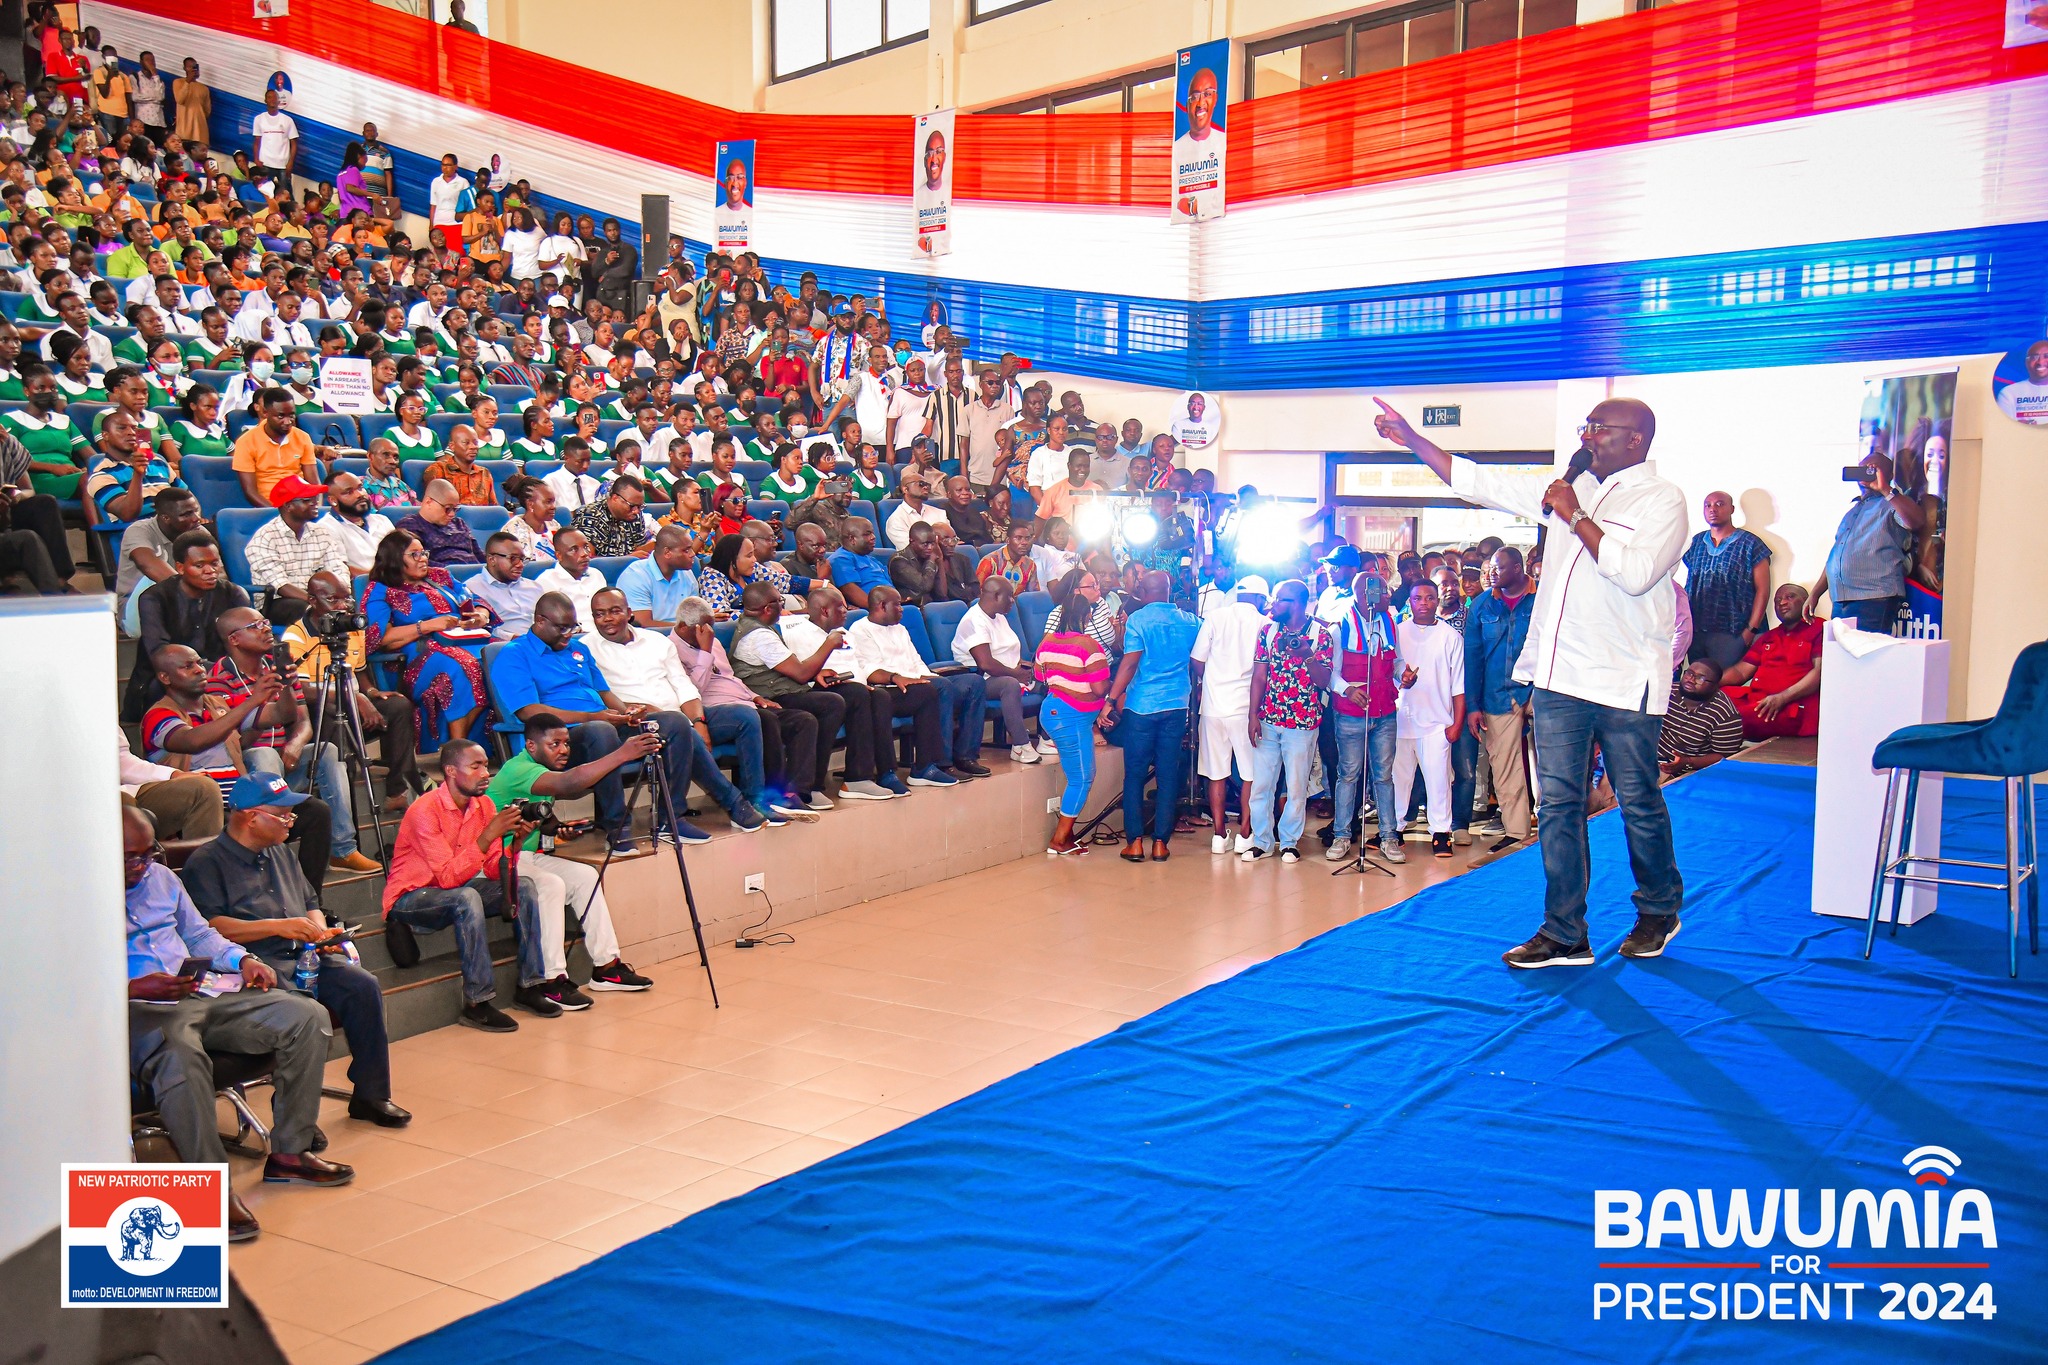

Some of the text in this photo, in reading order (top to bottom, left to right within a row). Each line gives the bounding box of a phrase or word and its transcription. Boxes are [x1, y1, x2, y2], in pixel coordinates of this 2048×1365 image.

[1179, 158, 1219, 175] BAWUMIA
[1179, 172, 1218, 185] PRESIDENT 2024
[919, 205, 947, 218] BAWUMIA
